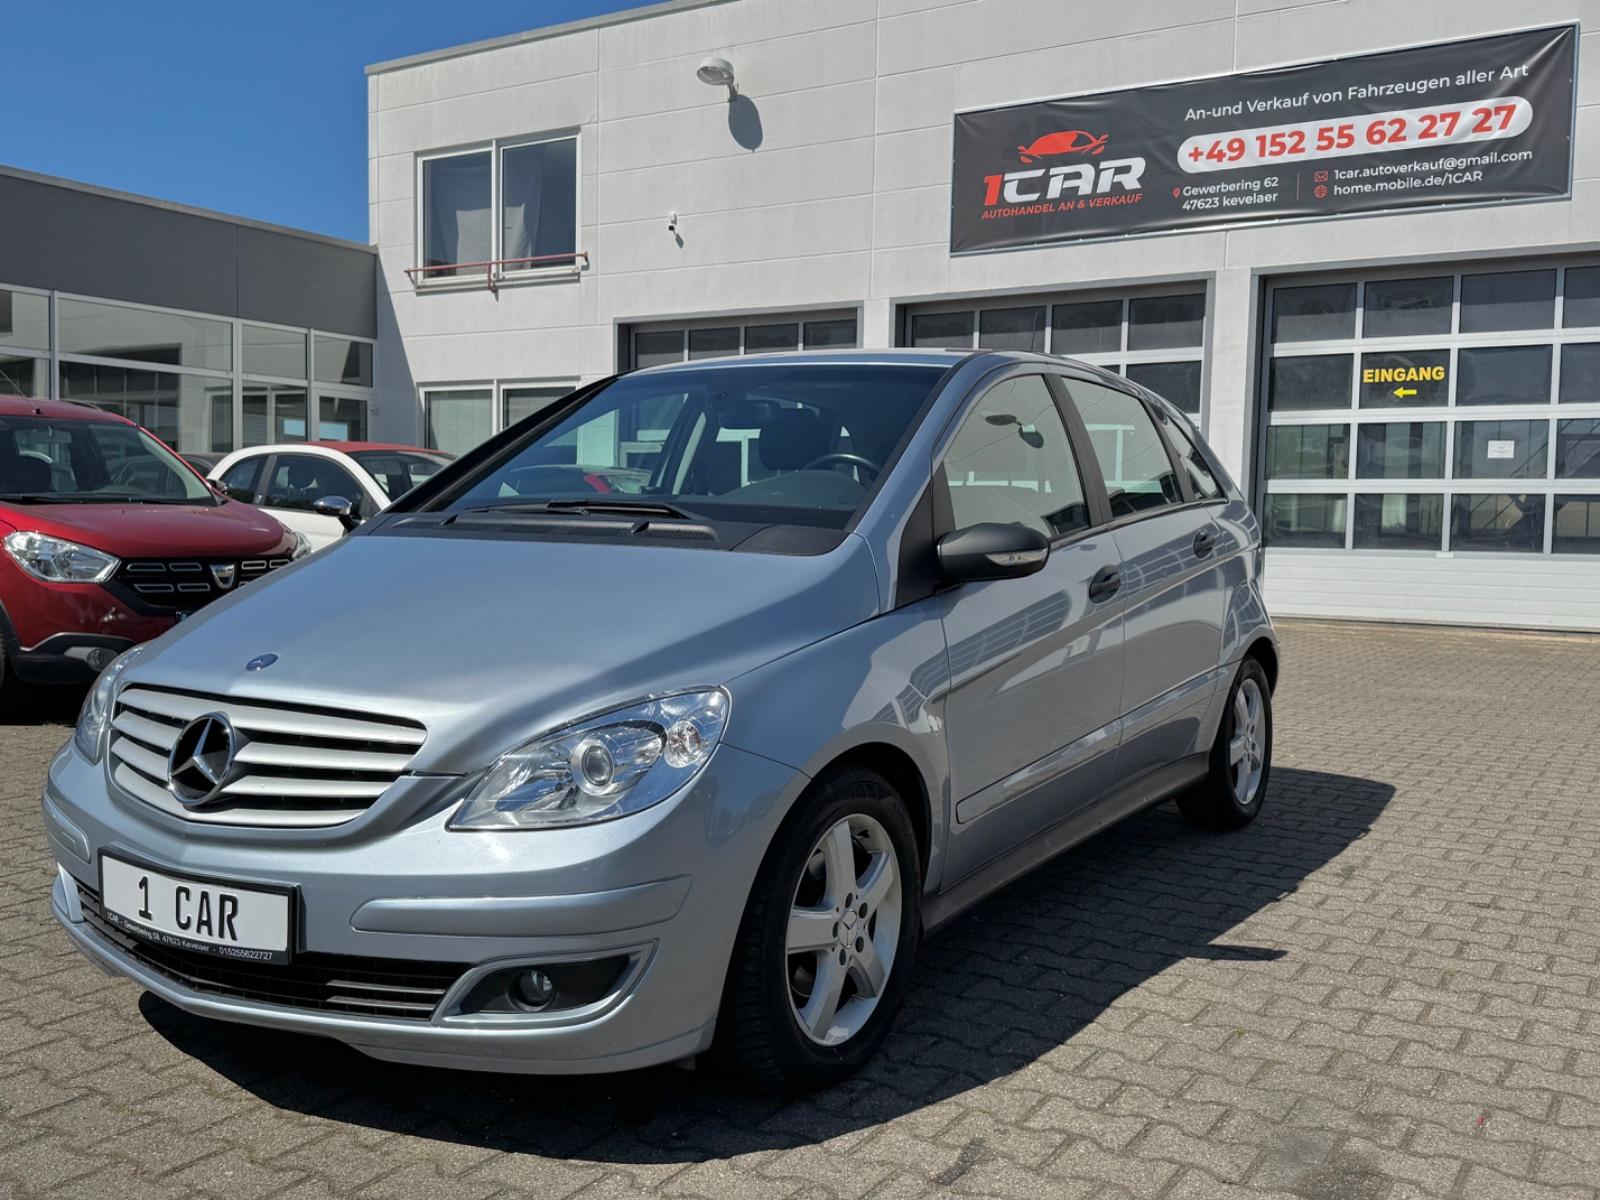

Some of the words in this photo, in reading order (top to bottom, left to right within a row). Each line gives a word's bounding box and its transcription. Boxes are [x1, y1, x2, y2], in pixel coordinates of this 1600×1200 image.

[1184, 101, 1242, 121] An-und
[1246, 92, 1309, 113] Verkauf
[1312, 90, 1342, 104] von
[1348, 75, 1450, 100] Fahrzeugen
[1455, 69, 1495, 86] aller
[1500, 64, 1528, 80] Art
[1188, 138, 1246, 163] +49
[1256, 130, 1306, 158] 152
[1316, 124, 1355, 151] 55
[1366, 118, 1407, 145] 62
[1418, 111, 1461, 139] 27
[1471, 104, 1517, 133] 27
[1334, 150, 1533, 180] 1car.autoverkauf@gmail.com
[984, 157, 1146, 207] 1CAR
[1182, 178, 1261, 197] Gewerbering
[1263, 176, 1279, 188] 62
[1334, 171, 1483, 196] home.mobile.de/1CAR
[981, 204, 1055, 220] AUTOHANDEL
[1057, 200, 1074, 211] AN
[1078, 200, 1086, 209] &
[1089, 193, 1143, 208] VERKAUF
[1182, 196, 1219, 211] 47623
[1222, 192, 1279, 207] kevelaer
[1363, 366, 1446, 383] EINGANG
[138, 875, 152, 920] 1
[175, 885, 239, 942] CAR
[219, 946, 273, 961] 015255622727
